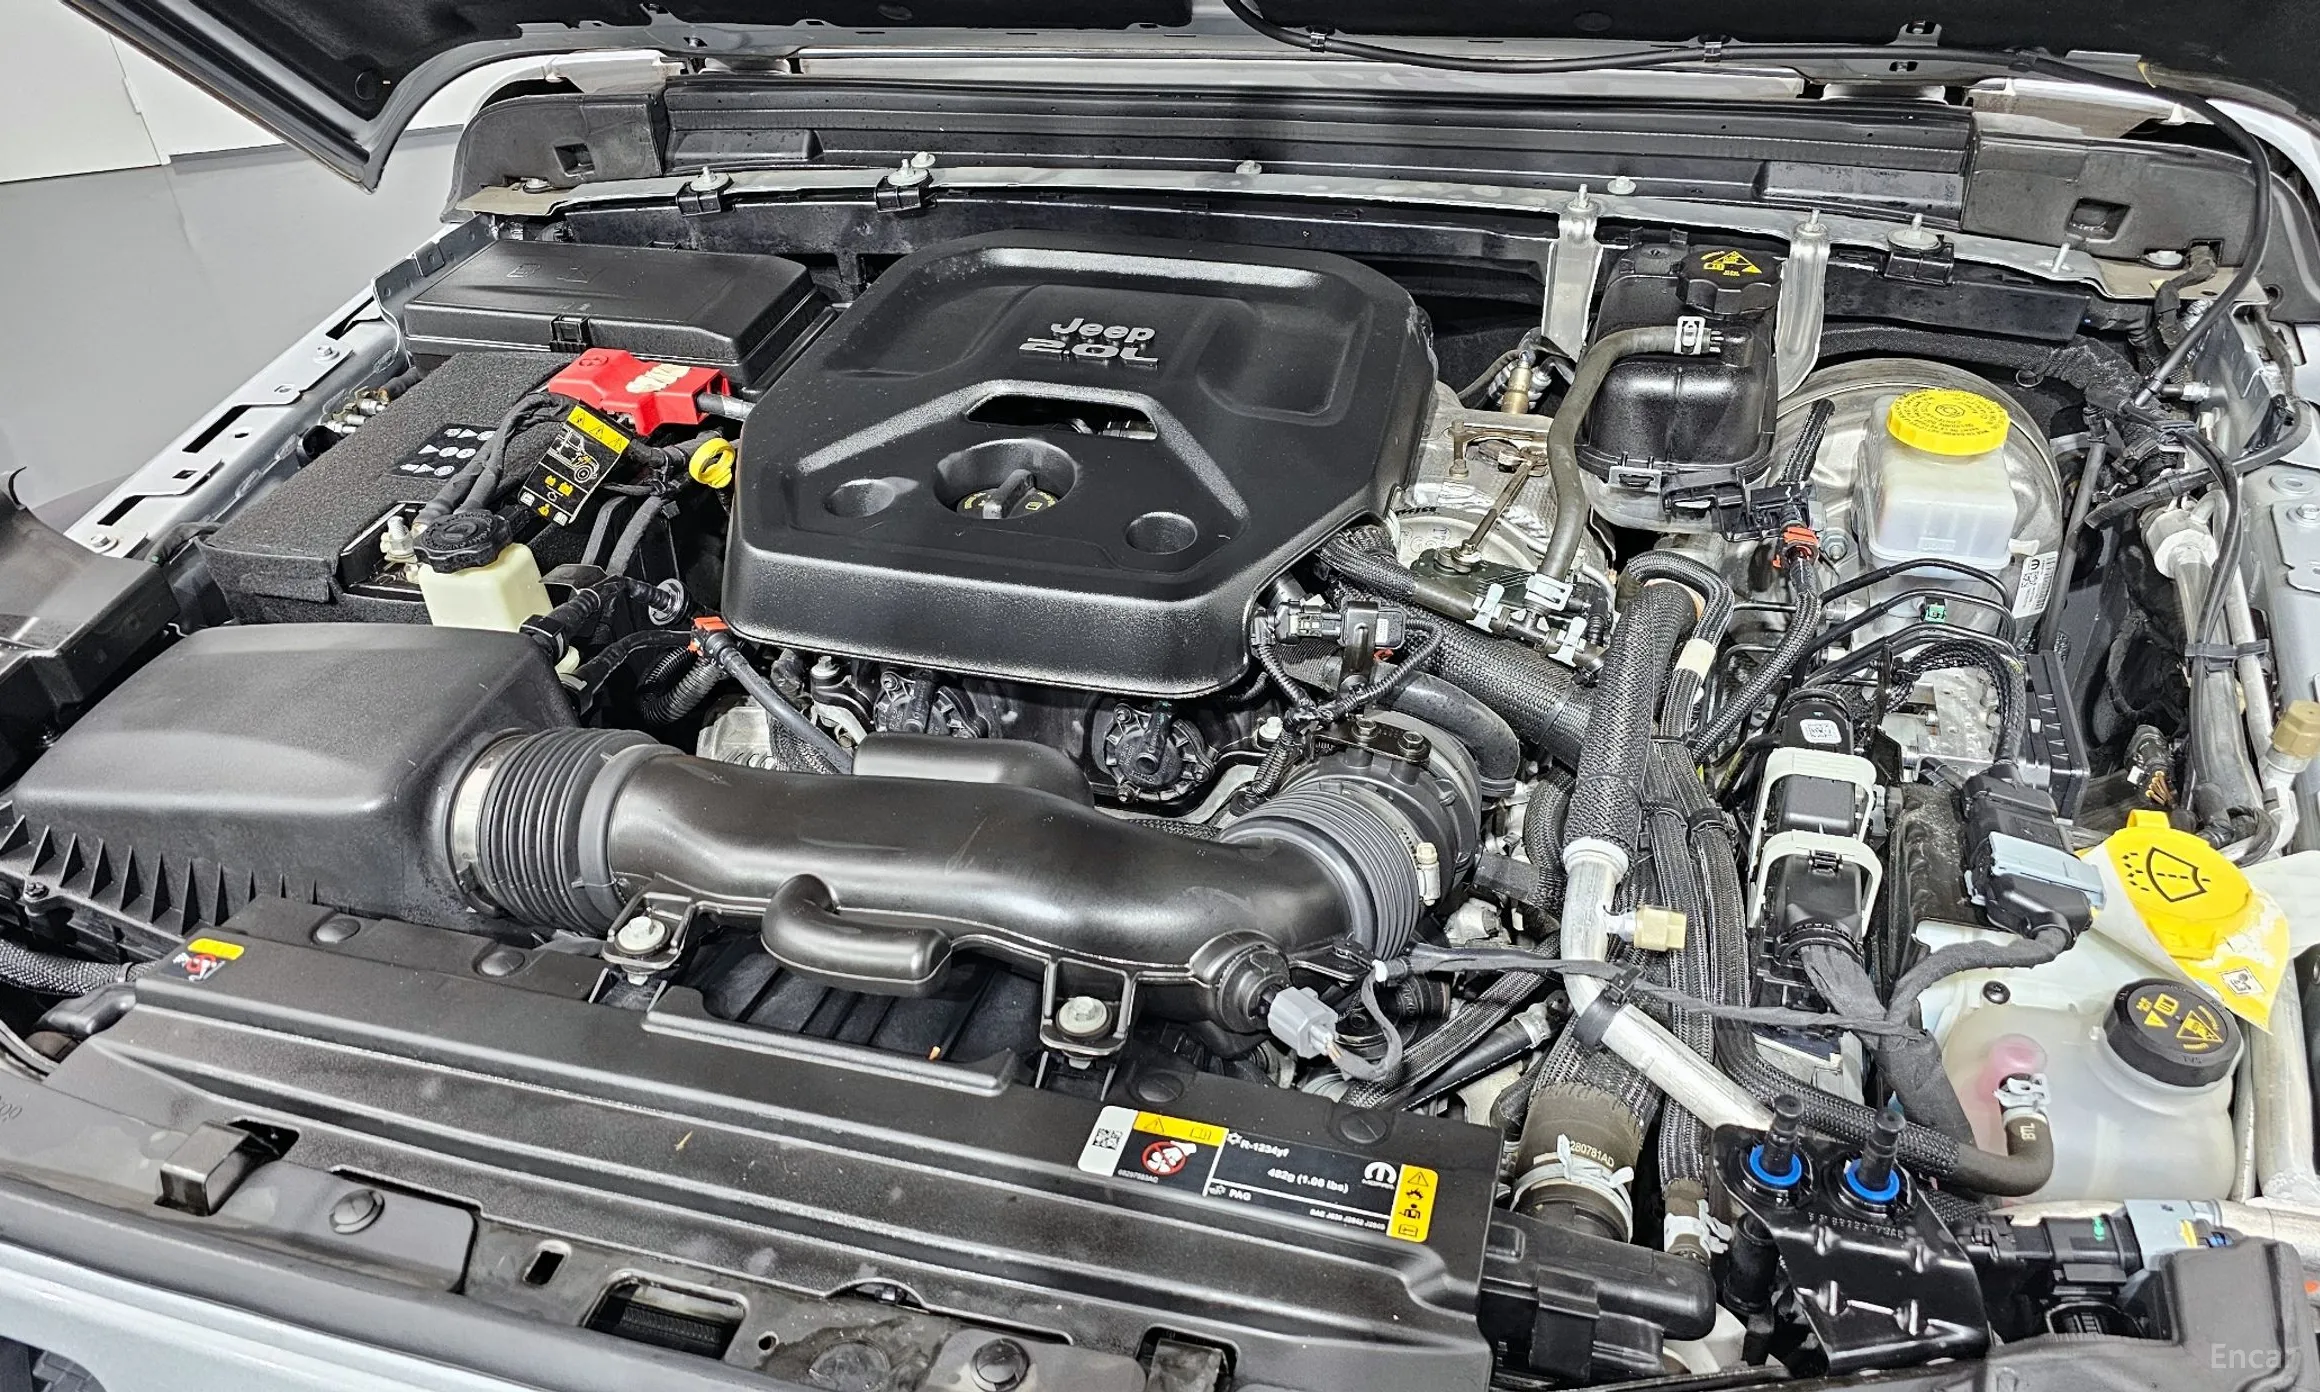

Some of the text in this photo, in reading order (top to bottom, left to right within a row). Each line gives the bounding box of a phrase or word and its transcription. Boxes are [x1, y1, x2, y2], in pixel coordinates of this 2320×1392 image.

[1050, 317, 1156, 343] Jeep
[1019, 337, 1159, 364] 2.0L
[2019, 1122, 2037, 1142] BTL
[1240, 1138, 1290, 1158] R-1234yf
